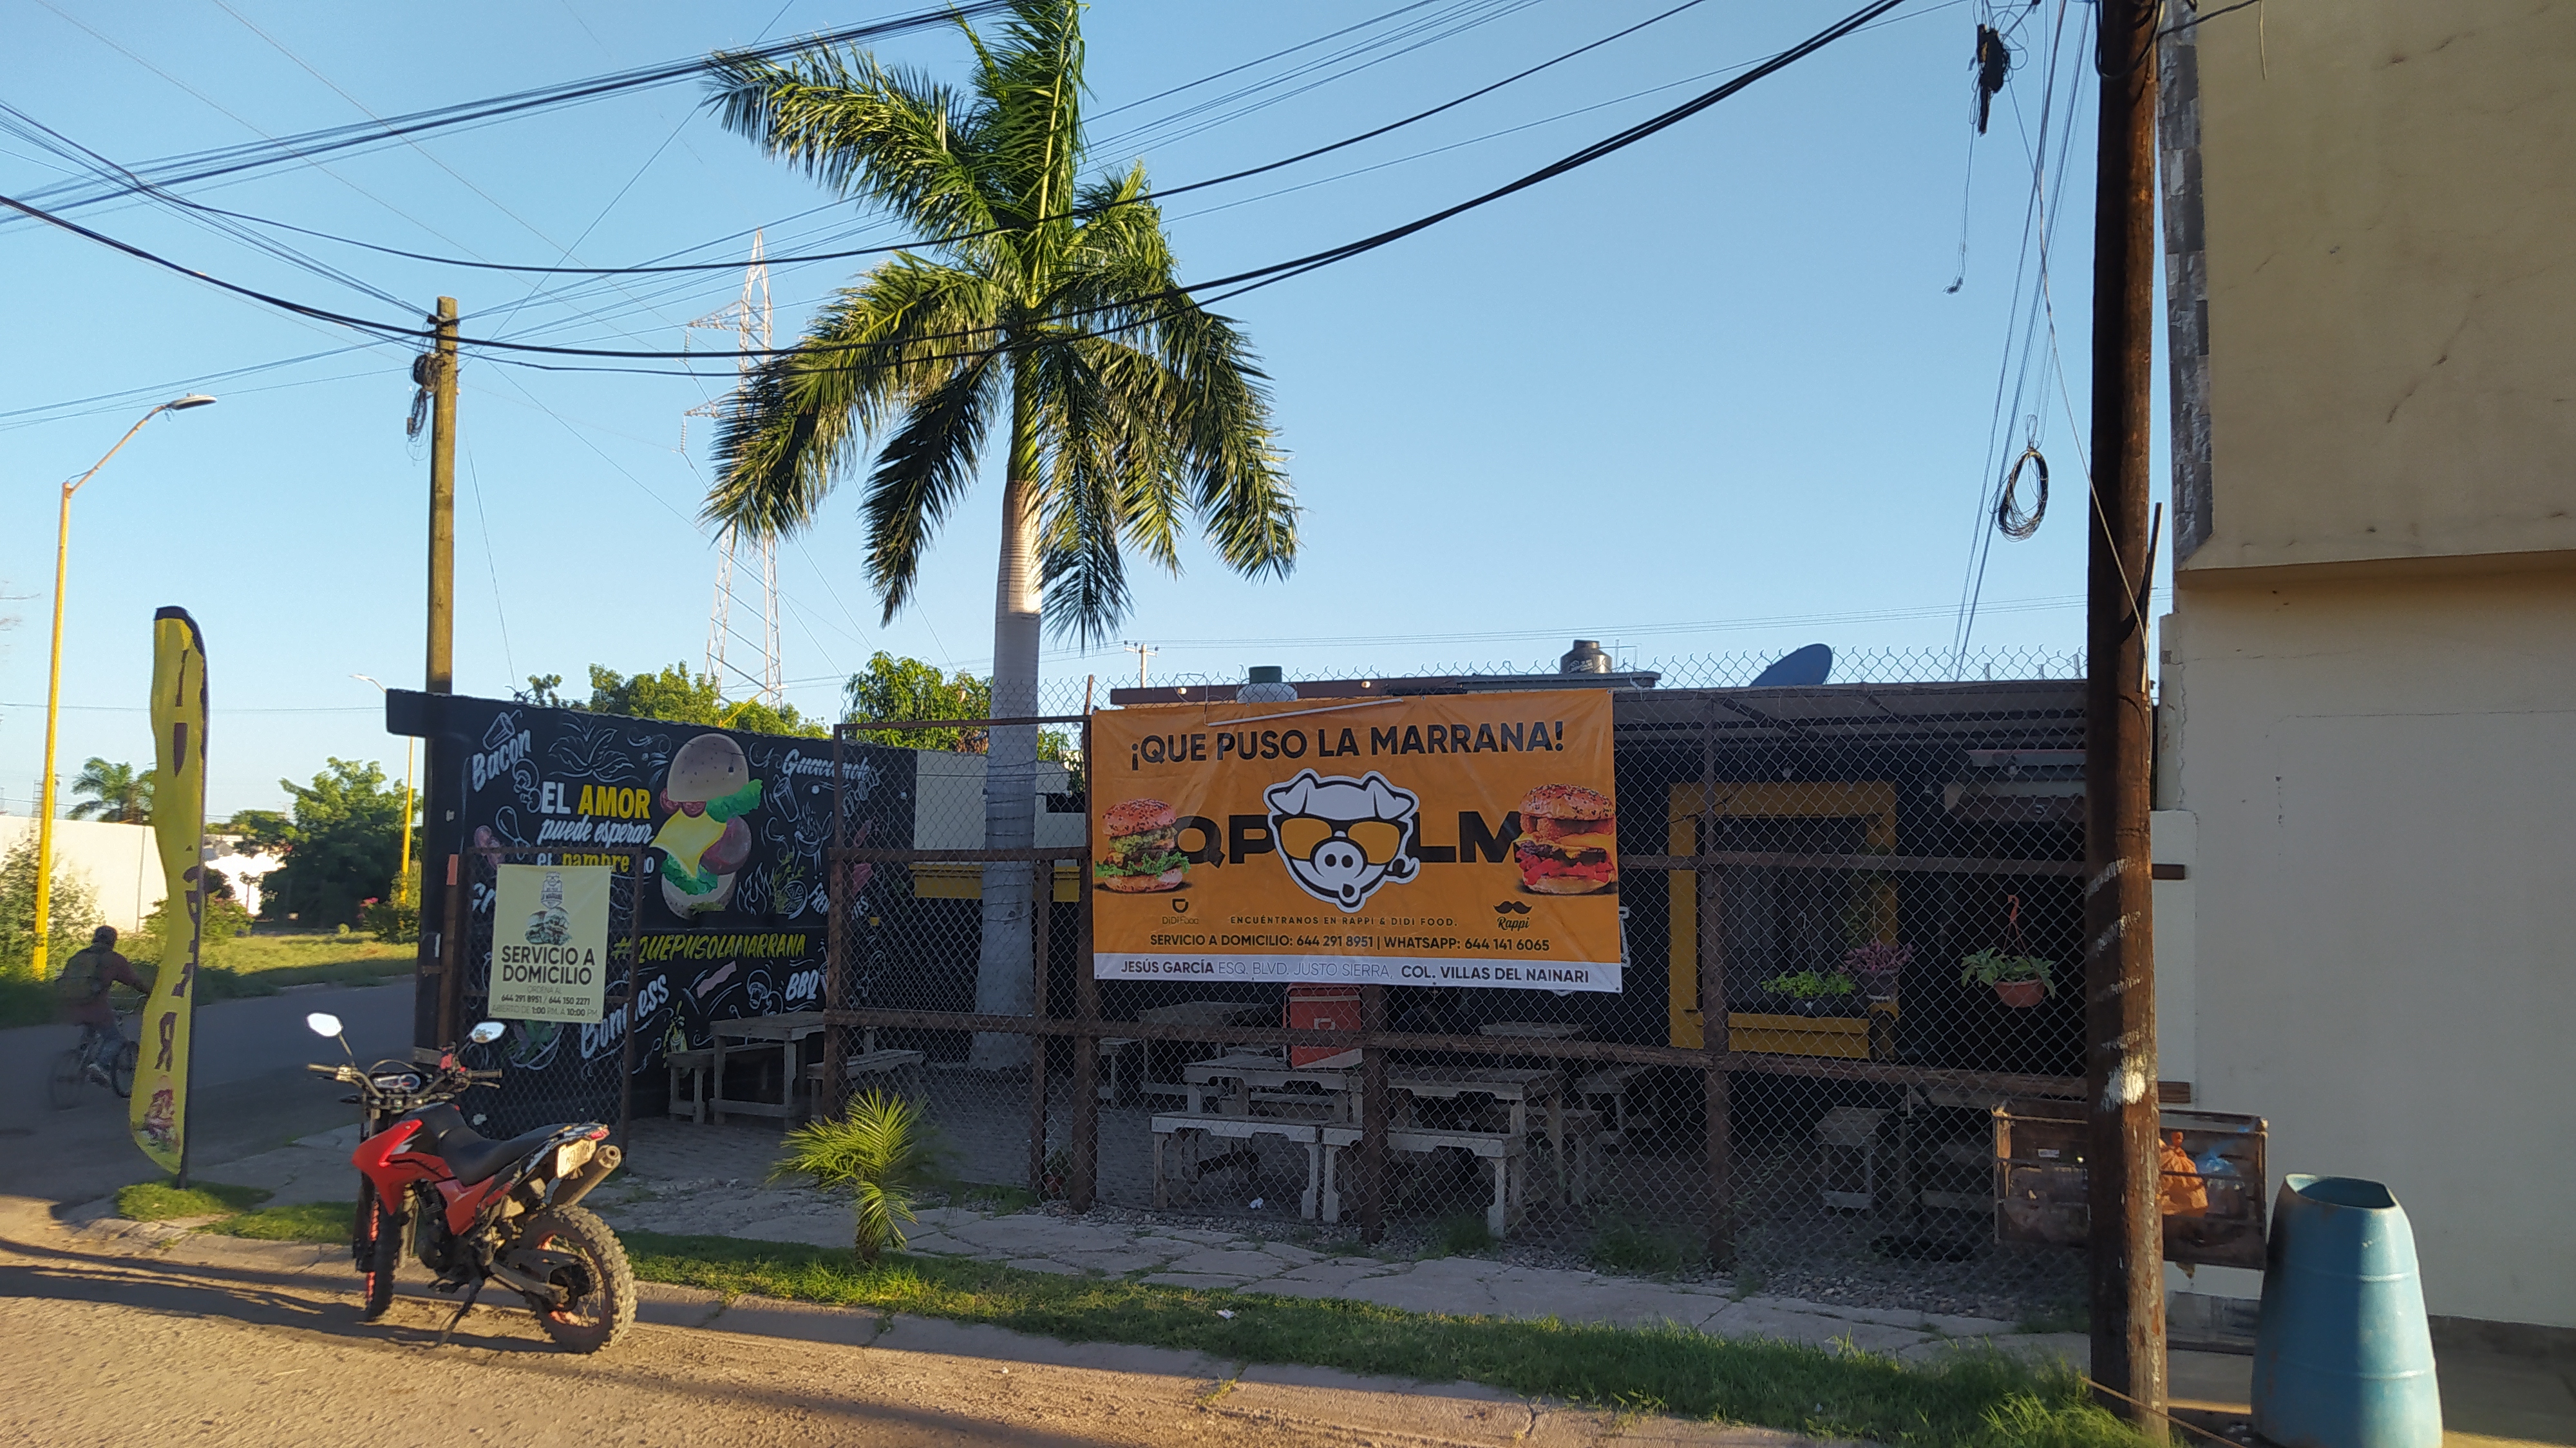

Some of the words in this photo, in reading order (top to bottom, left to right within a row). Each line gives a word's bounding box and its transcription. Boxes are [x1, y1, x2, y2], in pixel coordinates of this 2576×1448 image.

[1132, 734, 1206, 770] ¡QUE
[1217, 730, 1307, 761] PUSO
[1318, 728, 1361, 757] LA
[1371, 721, 1564, 756] MARRANA!
[471, 729, 531, 792] Bacon
[541, 781, 571, 814] EL
[578, 784, 650, 819] AMOR
[537, 814, 593, 845] puede
[594, 819, 655, 848] esperar
[1231, 915, 1318, 924] ENCUÉNTRANOS
[1391, 917, 1415, 926] DIDI
[1421, 918, 1458, 927] FOOD.
[1497, 916, 1531, 931] Rappi
[1150, 935, 1206, 946] SERVICIO
[1208, 935, 1217, 946] A
[1221, 935, 1293, 947] DOMICILIO:
[1296, 935, 1320, 947] 644
[1323, 936, 1342, 947] 291
[1345, 936, 1373, 948] 8951
[1384, 937, 1461, 949] WHATSAPP:
[1464, 938, 1490, 950] 644
[1493, 938, 1512, 950] 141
[1516, 939, 1549, 951] 6065
[502, 945, 578, 965] SERVICIO
[583, 948, 595, 966] A
[503, 964, 592, 985] DOMICILIO
[1121, 958, 1159, 973] JESÚS
[1162, 959, 1215, 974] GARCÍA
[1218, 962, 1248, 975] ESQ.
[1253, 962, 1289, 975] BLVD.
[1293, 962, 1338, 976] JUSTO
[1342, 964, 1393, 979] SIERRA,
[1401, 966, 1435, 978] COL.
[1440, 966, 1490, 980] VILLAS
[1495, 967, 1521, 980] DEL
[1526, 968, 1589, 983] NAINARI
[785, 969, 819, 1001] BBQ
[567, 1008, 585, 1016] 10:00
